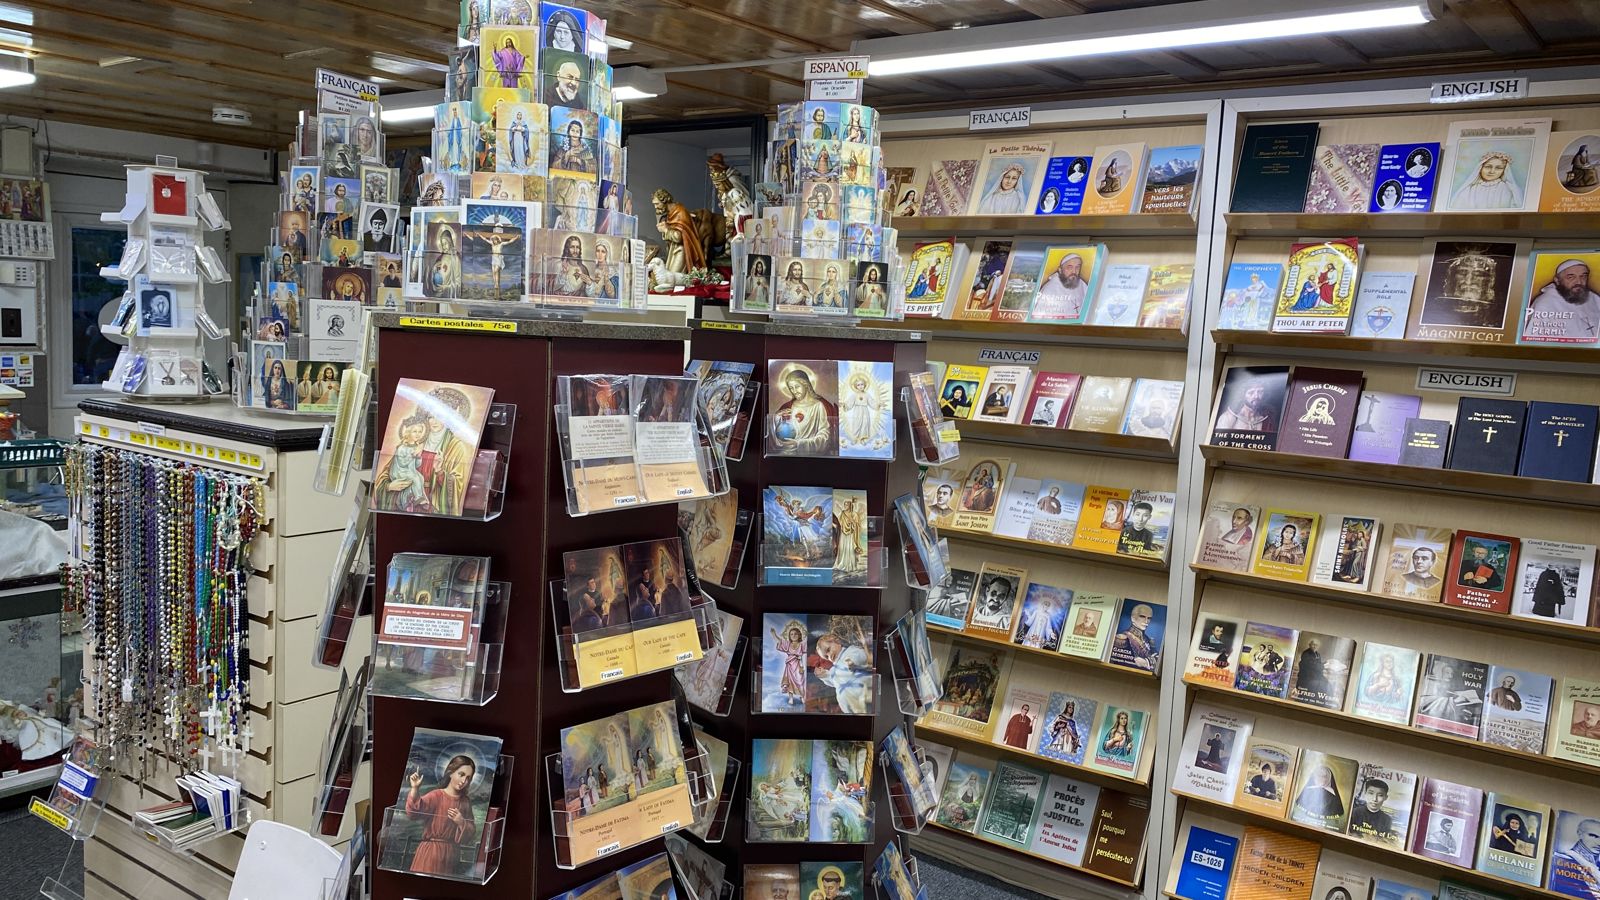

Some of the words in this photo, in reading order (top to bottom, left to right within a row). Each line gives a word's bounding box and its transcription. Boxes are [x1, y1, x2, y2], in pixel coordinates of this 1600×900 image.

[809, 59, 862, 74] ESPAÑOL
[321, 73, 377, 96] FRANÇAIS
[1440, 79, 1520, 97] ENGLISH
[971, 110, 1029, 125] FRANÇAIS
[1525, 308, 1574, 321] PROPHET
[409, 317, 441, 326] Cartes
[443, 320, 484, 328] postales
[1276, 319, 1297, 327] THOU
[1416, 326, 1504, 342] MAGNIFICAT
[1532, 326, 1567, 335] PERMIT
[980, 349, 1039, 362] FRANÇAIS
[1428, 372, 1504, 388] ENGLISH
[1301, 383, 1322, 394] JESUS
[1322, 383, 1348, 396] CHRIST
[1230, 432, 1266, 441] TORMENT
[1231, 441, 1246, 449] THE
[1247, 442, 1272, 450] CROSS
[1159, 495, 1174, 504] Van
[1334, 554, 1342, 573] SAINT
[1457, 593, 1490, 603] Roderick
[1466, 589, 1491, 598] Father
[676, 652, 693, 662] English
[601, 670, 623, 679] Francais
[1201, 671, 1230, 683] DEVIL
[1461, 671, 1484, 681] HOLY
[1463, 680, 1483, 689] WAR
[1292, 687, 1316, 698] ALFRED
[1395, 772, 1413, 785] Van
[1066, 784, 1078, 793] LE
[1053, 791, 1086, 806] PROCÈS
[1054, 802, 1066, 812] DE
[1068, 805, 1079, 815] LA
[662, 822, 679, 833] English
[1102, 824, 1126, 836] pourquoi
[1352, 823, 1378, 836] Triumph
[1362, 821, 1373, 829] The
[1099, 836, 1108, 844] me
[597, 842, 620, 856] Francais
[1202, 847, 1217, 856] Agent
[1095, 846, 1134, 866] persécutes-tu?
[1193, 852, 1223, 868] ES-1026
[1488, 852, 1536, 871] MELANIE
[1556, 858, 1593, 873] GARCIA
[1243, 865, 1269, 877] HIDDEN
[1270, 871, 1305, 888] CHILDREN
